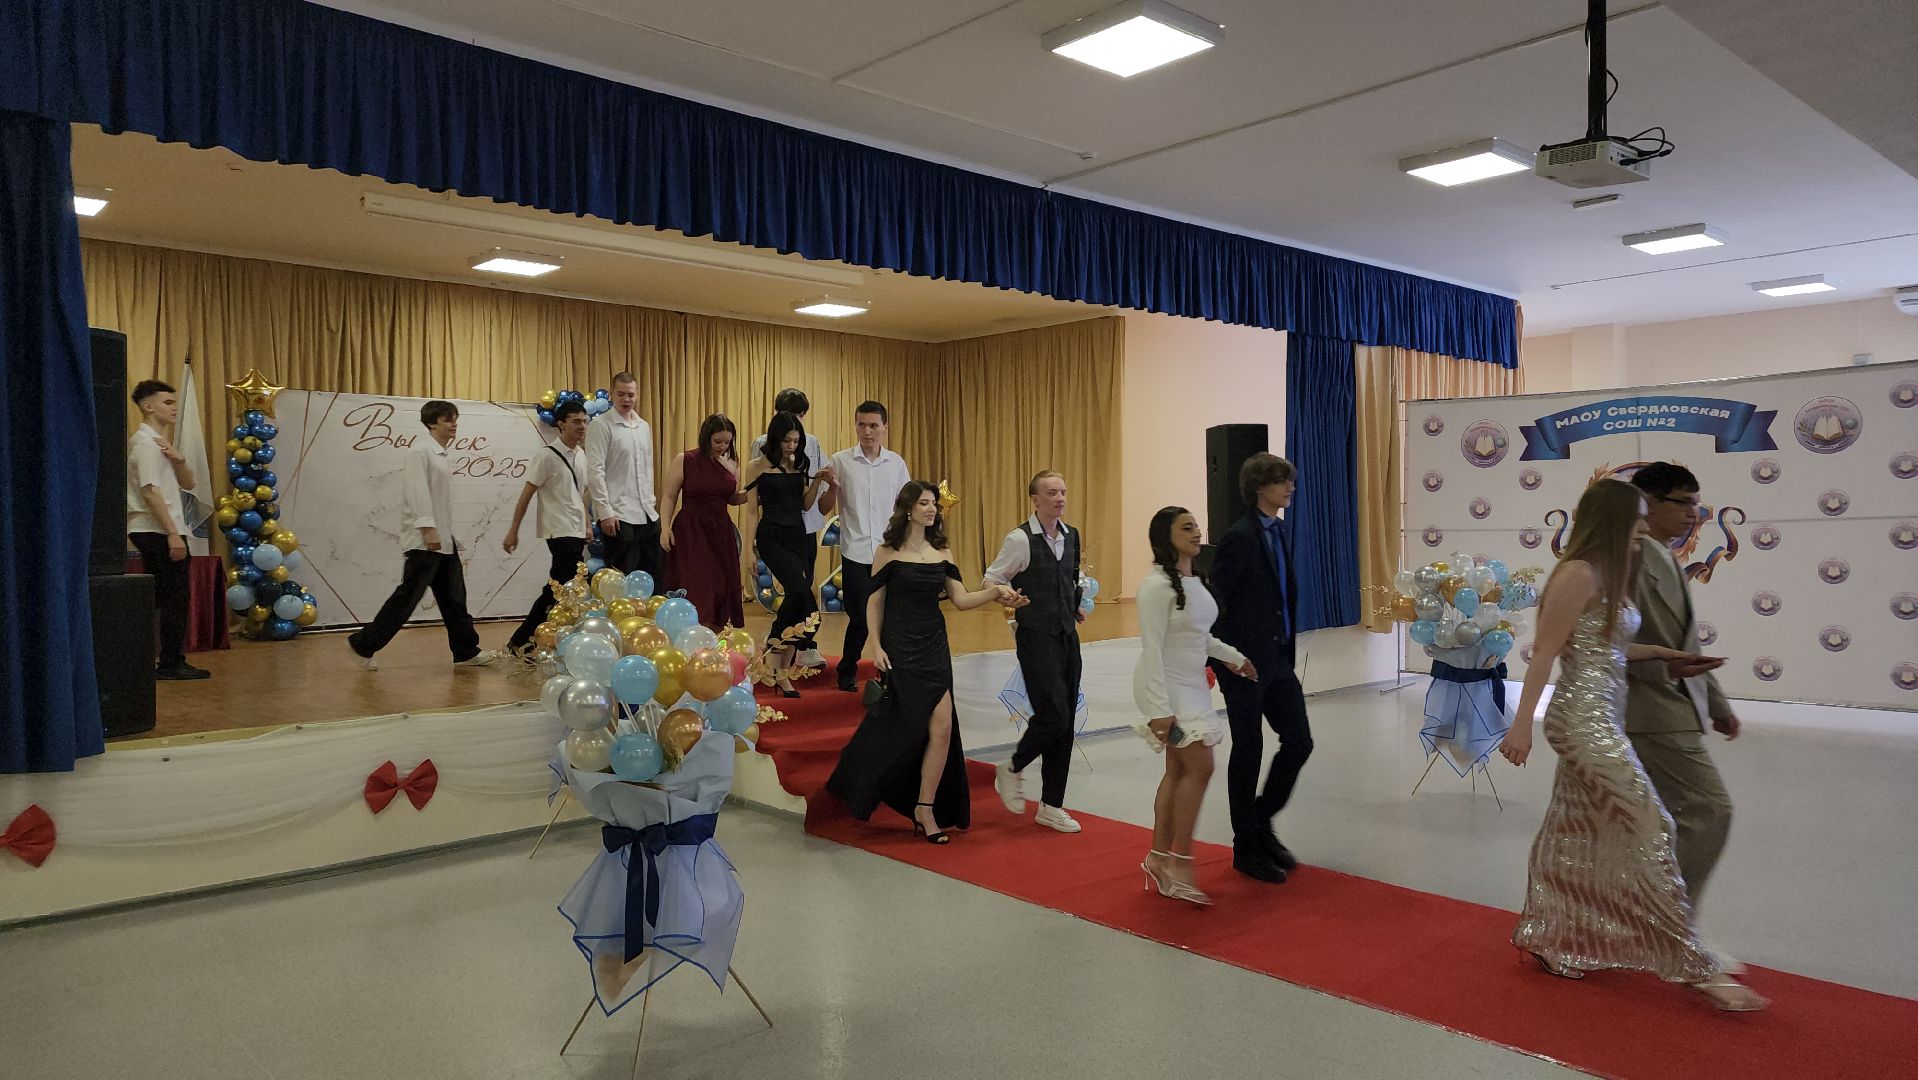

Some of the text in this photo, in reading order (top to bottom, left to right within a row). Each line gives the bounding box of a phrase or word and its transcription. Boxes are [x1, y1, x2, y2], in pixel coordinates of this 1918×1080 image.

[343, 402, 490, 451] Выск
[1555, 405, 1731, 429] МАОУ Свердловская
[1602, 417, 1676, 431] СОШ №2
[452, 455, 529, 478] 2025
